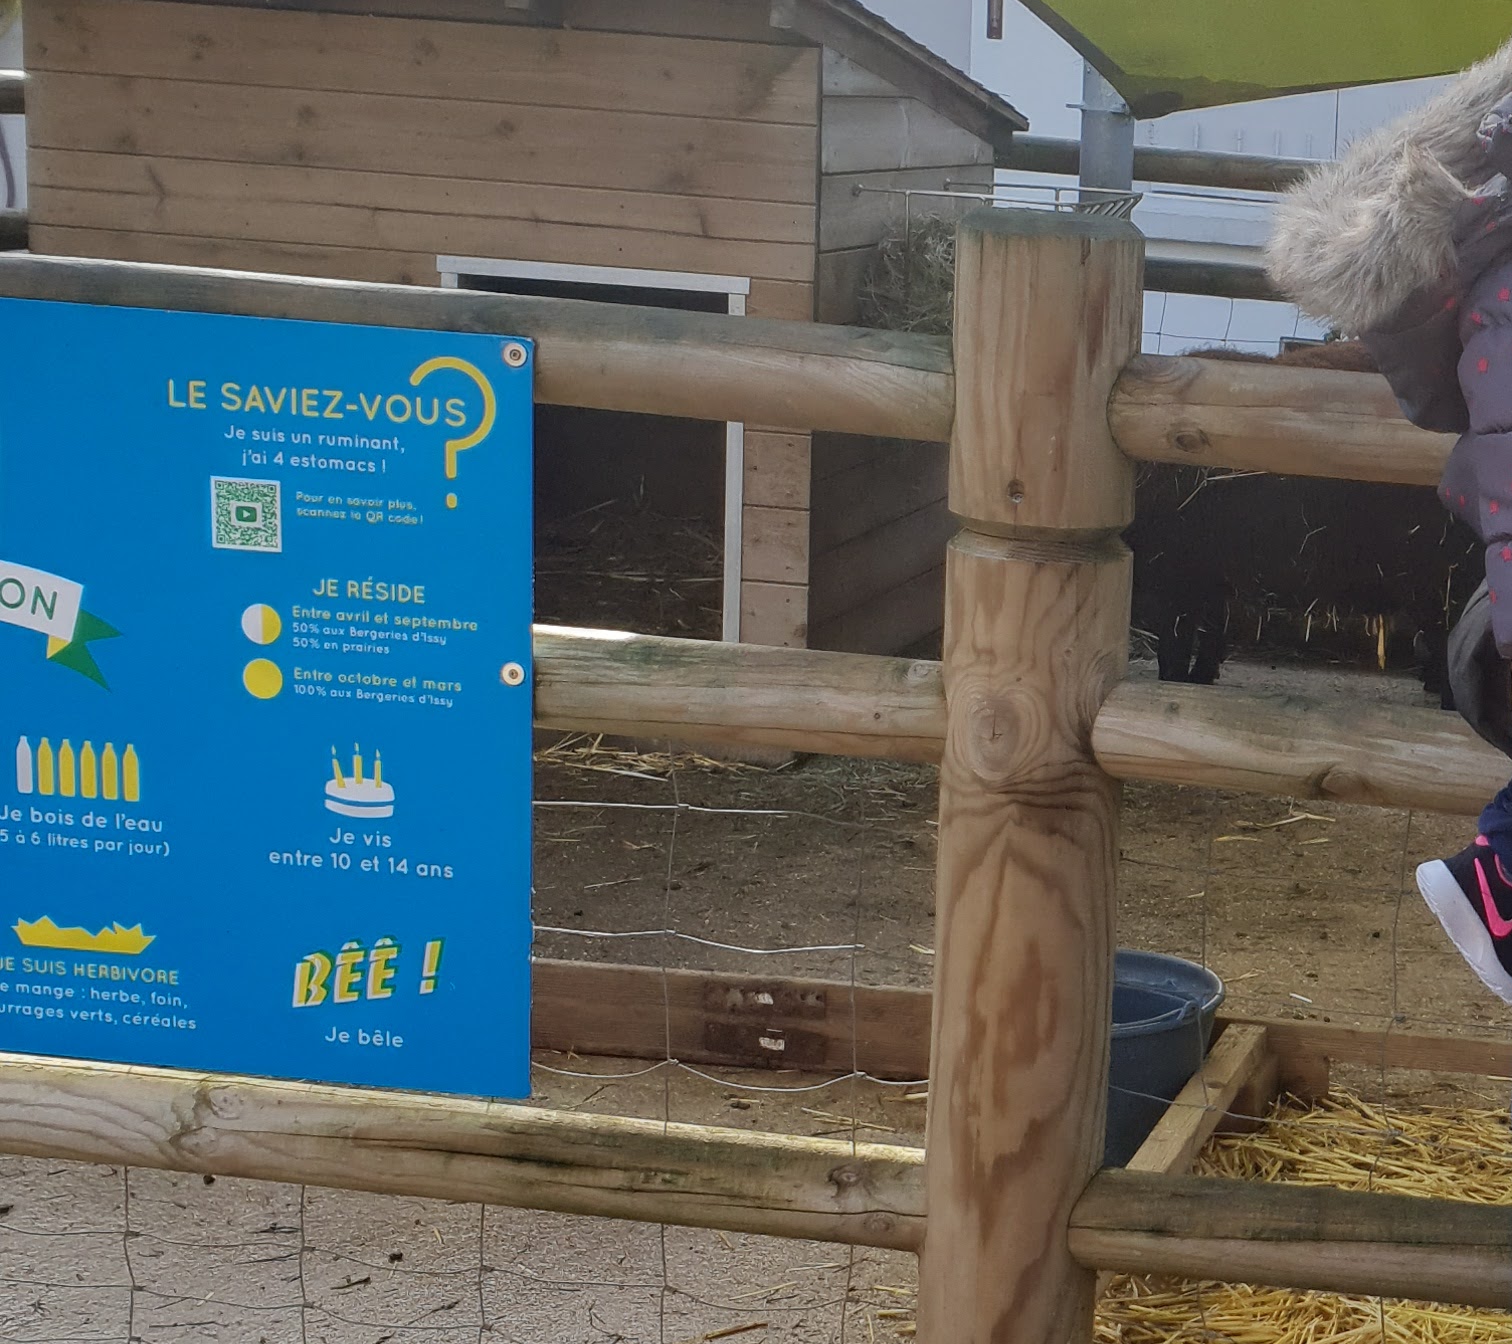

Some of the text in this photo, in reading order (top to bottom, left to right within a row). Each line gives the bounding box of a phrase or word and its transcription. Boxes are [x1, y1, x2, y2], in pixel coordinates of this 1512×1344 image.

[167, 378, 207, 409] LE
[221, 382, 467, 428] SAVIEZ-VOUS
[224, 425, 406, 453] Je suis un ruminant,
[242, 449, 267, 467] j'ai
[273, 451, 285, 465] 4
[290, 453, 376, 472] estomacs
[296, 491, 324, 503] Pour
[328, 495, 343, 505] en
[347, 497, 384, 507] savoir
[296, 508, 347, 519] scannez
[366, 511, 384, 523] QR
[312, 576, 426, 604] JE RÉSIDE
[292, 606, 478, 632] Entre avril et septembre
[293, 622, 320, 634] 50%
[323, 626, 345, 636] aux
[350, 626, 408, 642] Bergeries
[293, 637, 390, 654] 50% en prairies
[293, 667, 462, 692] Entre octobre et mars
[294, 684, 327, 697] 100%
[330, 688, 352, 698] aux
[356, 689, 415, 703] Bergeries
[0, 805, 163, 832] Je bois de l'eau
[15, 829, 26, 844] à
[31, 831, 41, 845] 6
[47, 832, 89, 850] litres
[94, 839, 124, 853] par
[128, 840, 170, 857] jour)
[329, 827, 392, 847] Je vis
[269, 850, 454, 879] entre 10 et 14 ans
[22, 957, 67, 976] SUIS
[74, 963, 180, 985] HERBIVORE
[292, 935, 402, 1008] BÊÊ
[15, 983, 75, 999] mange
[90, 987, 146, 1006] herbe,
[151, 992, 188, 1009] foin,
[70, 1009, 118, 1026] verts,
[122, 1011, 197, 1030] céréales
[325, 1026, 404, 1048] Je bêle
